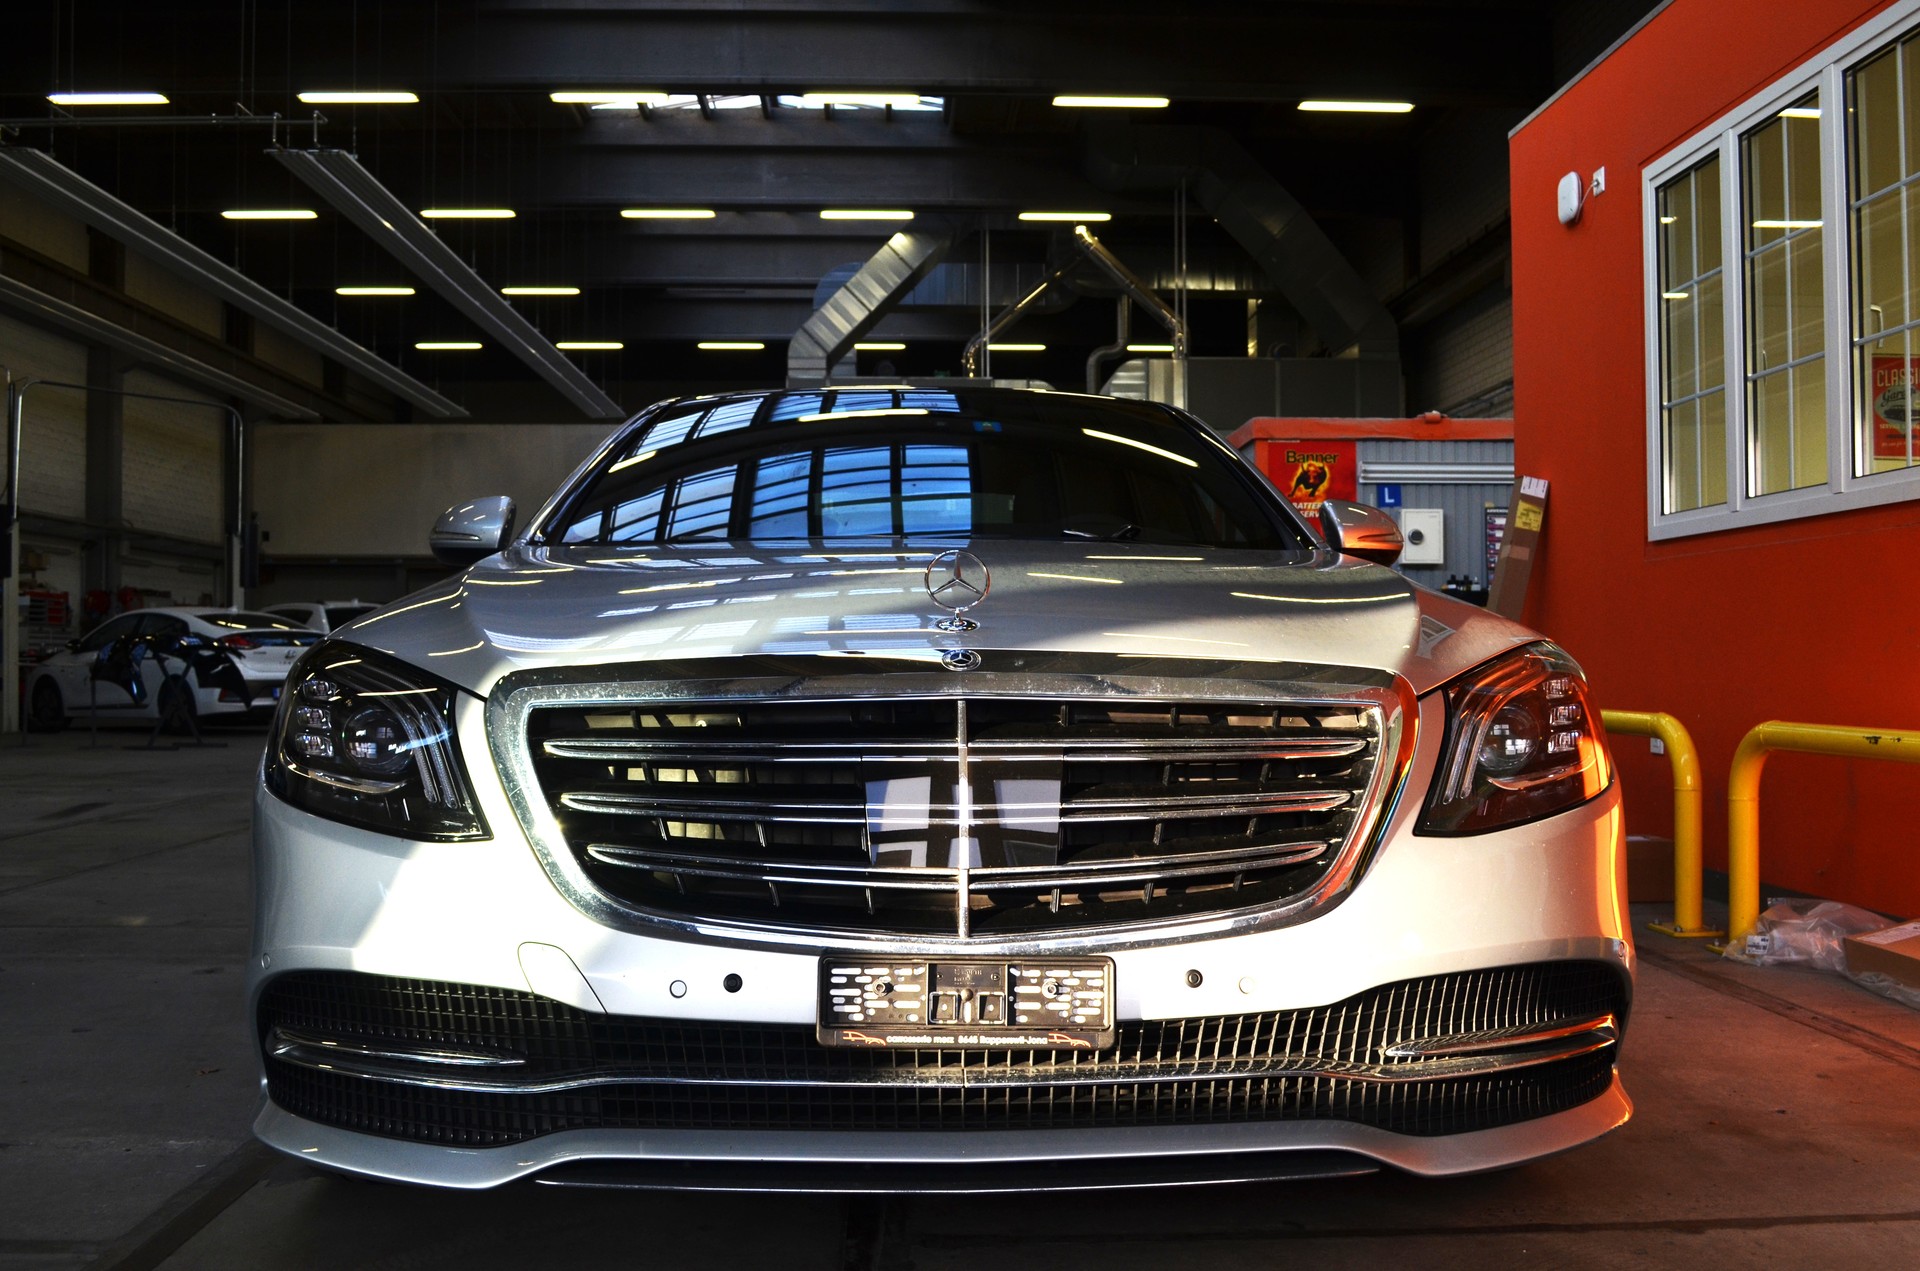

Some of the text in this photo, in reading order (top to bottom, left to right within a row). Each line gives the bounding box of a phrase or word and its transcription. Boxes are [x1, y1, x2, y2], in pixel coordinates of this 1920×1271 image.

[1876, 368, 1920, 387] CLASSI
[1286, 450, 1338, 463] Banner
[1384, 487, 1395, 503] L
